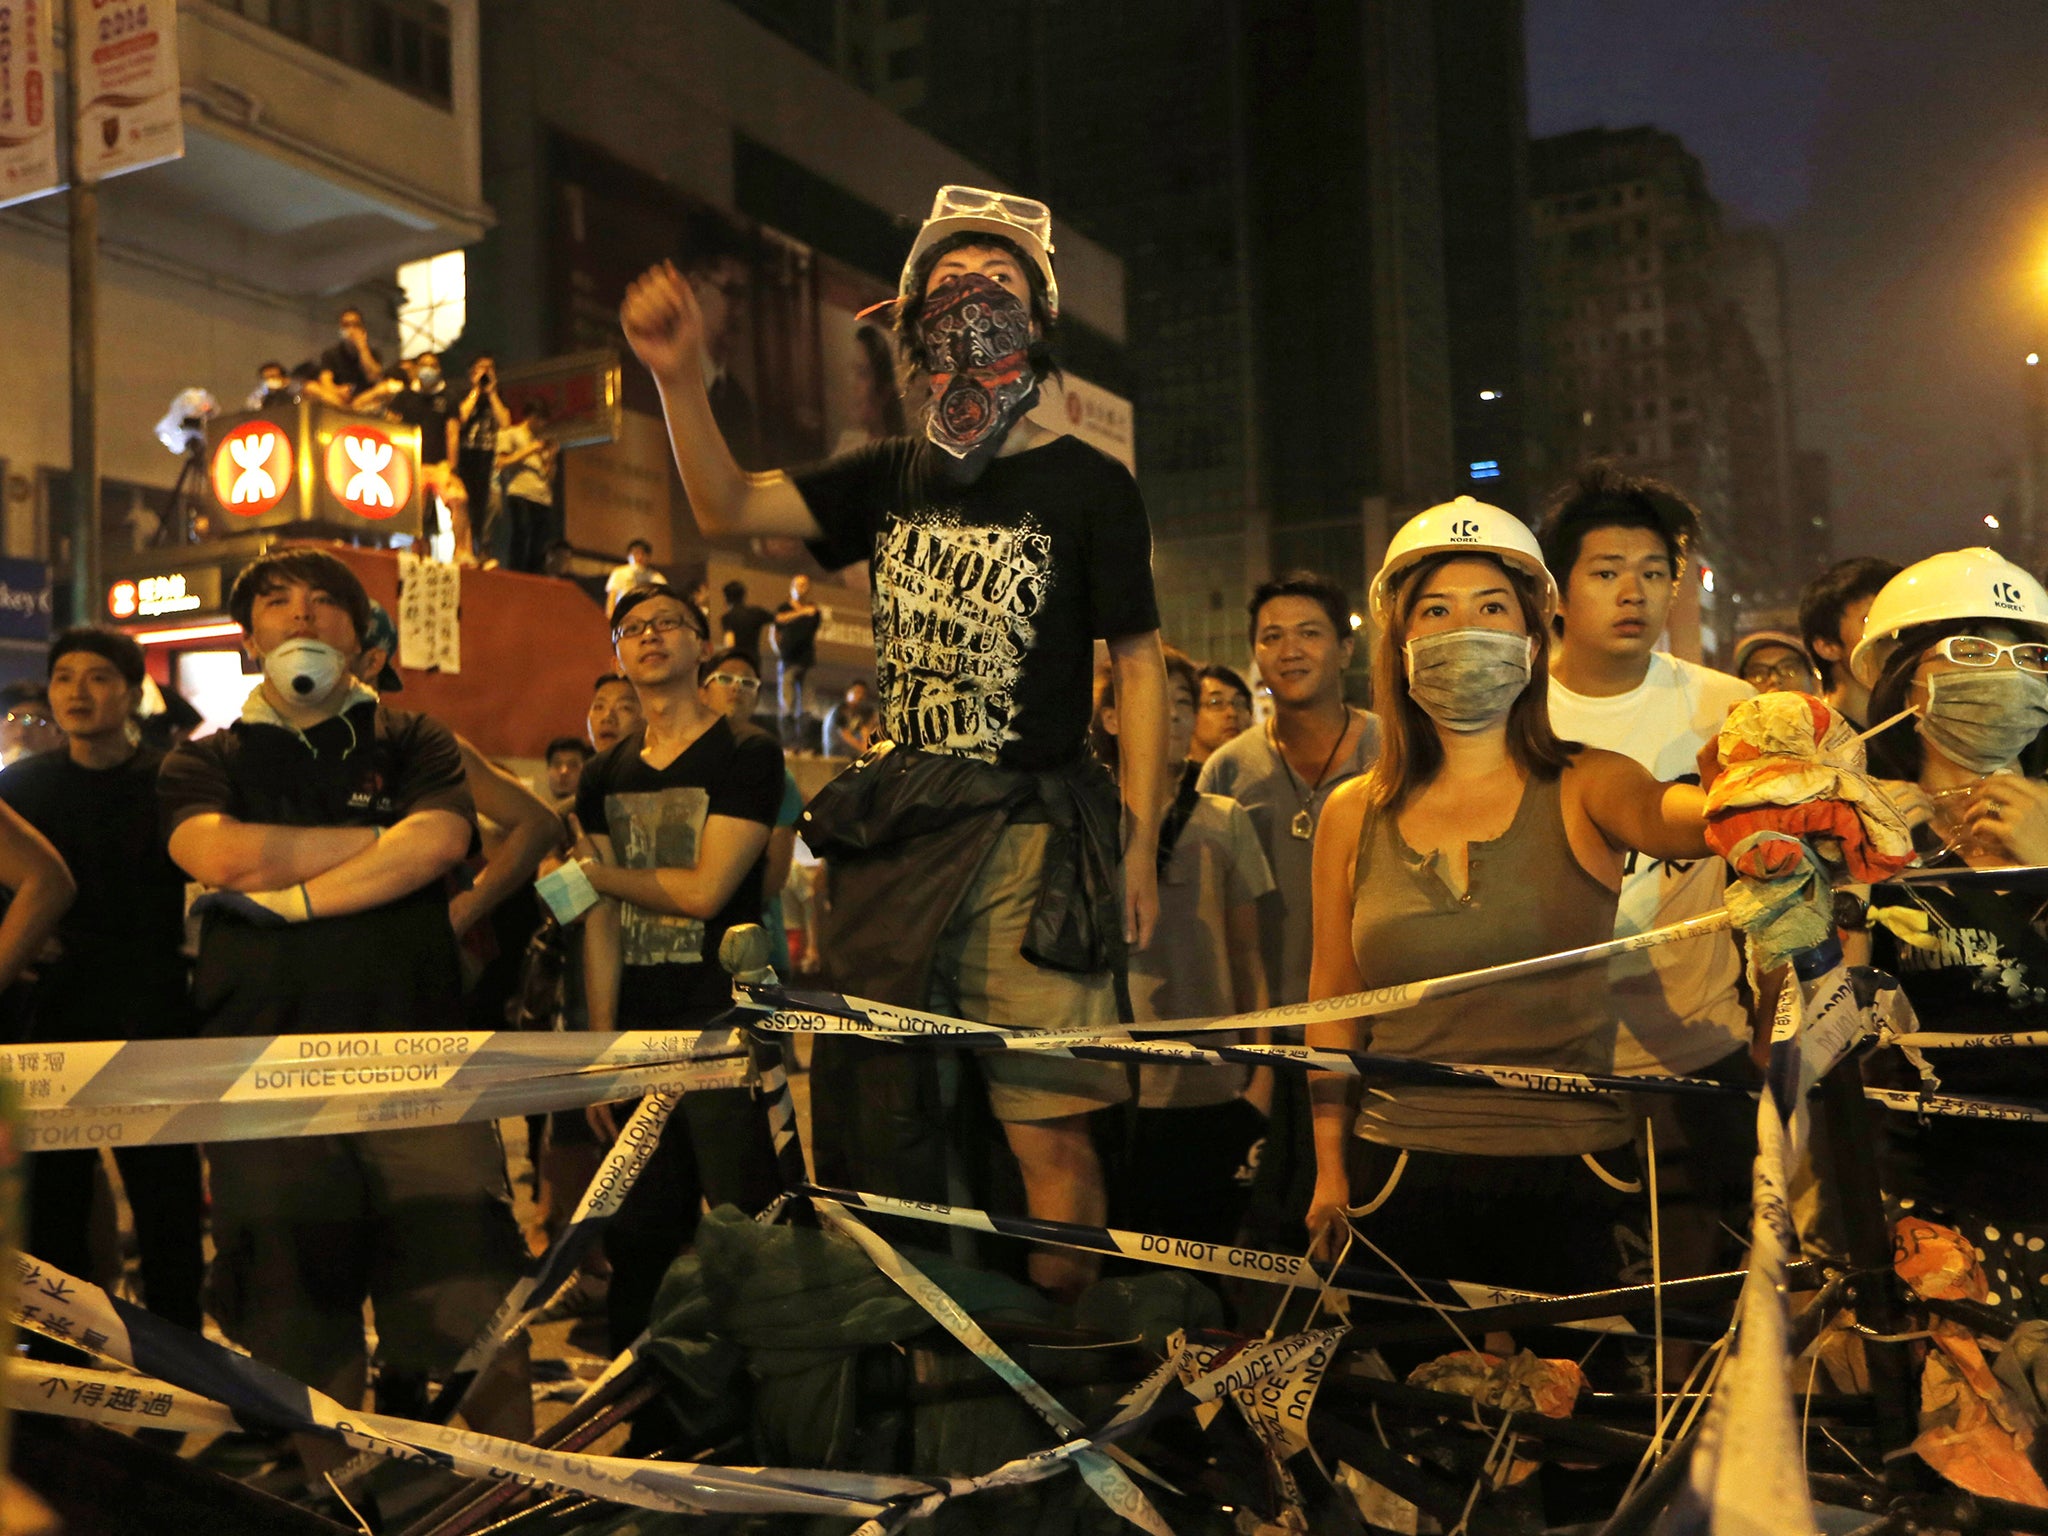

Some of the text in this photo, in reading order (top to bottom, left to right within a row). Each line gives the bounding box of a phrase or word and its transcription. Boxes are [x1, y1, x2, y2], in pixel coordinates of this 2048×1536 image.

[1994, 601, 2023, 612] KOREL
[763, 1014, 826, 1030] CROSS
[624, 1115, 652, 1152] NOT
[588, 1155, 626, 1211] CROSS
[1141, 1235, 1302, 1276] DO NOT CROSS
[1214, 1354, 1274, 1397] POLICE
